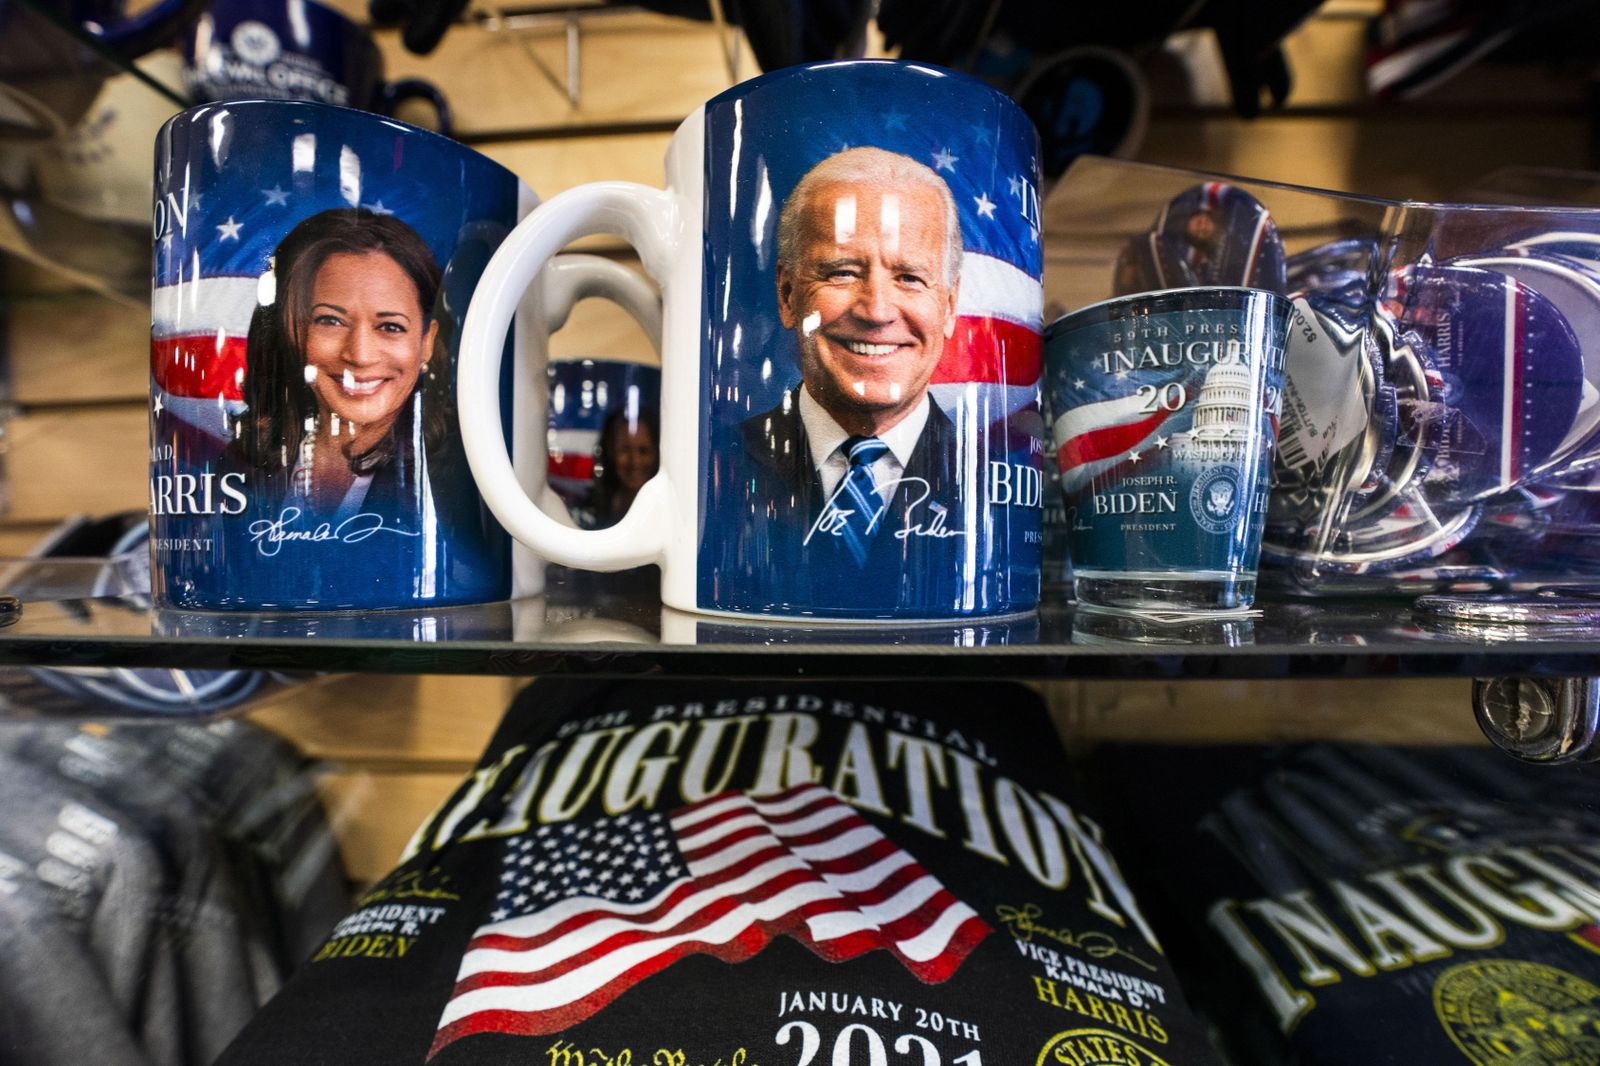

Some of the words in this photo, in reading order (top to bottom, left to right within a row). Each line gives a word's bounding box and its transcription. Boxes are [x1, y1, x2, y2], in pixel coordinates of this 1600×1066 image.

[1112, 326, 1169, 344] 59TH
[1437, 311, 1452, 368] HARRIS
[1135, 381, 1187, 415] 20
[1122, 476, 1163, 488] JOSEPH
[1166, 474, 1179, 486] R.
[1094, 491, 1179, 515] BIDEN
[1119, 522, 1177, 532] PRESIDENT
[652, 694, 998, 767] PRESIDENTIAL
[311, 933, 418, 964] BIDEN
[1014, 938, 1063, 969] VICE
[1064, 955, 1167, 1005] PRESIDENT
[1044, 964, 1124, 1001] KAMALA
[1126, 991, 1151, 1010] D.
[778, 990, 903, 1022] JANUARY
[914, 1007, 982, 1042] 20TH
[1032, 974, 1169, 1045] HARRIS
[1053, 1035, 1142, 1066] STATES
